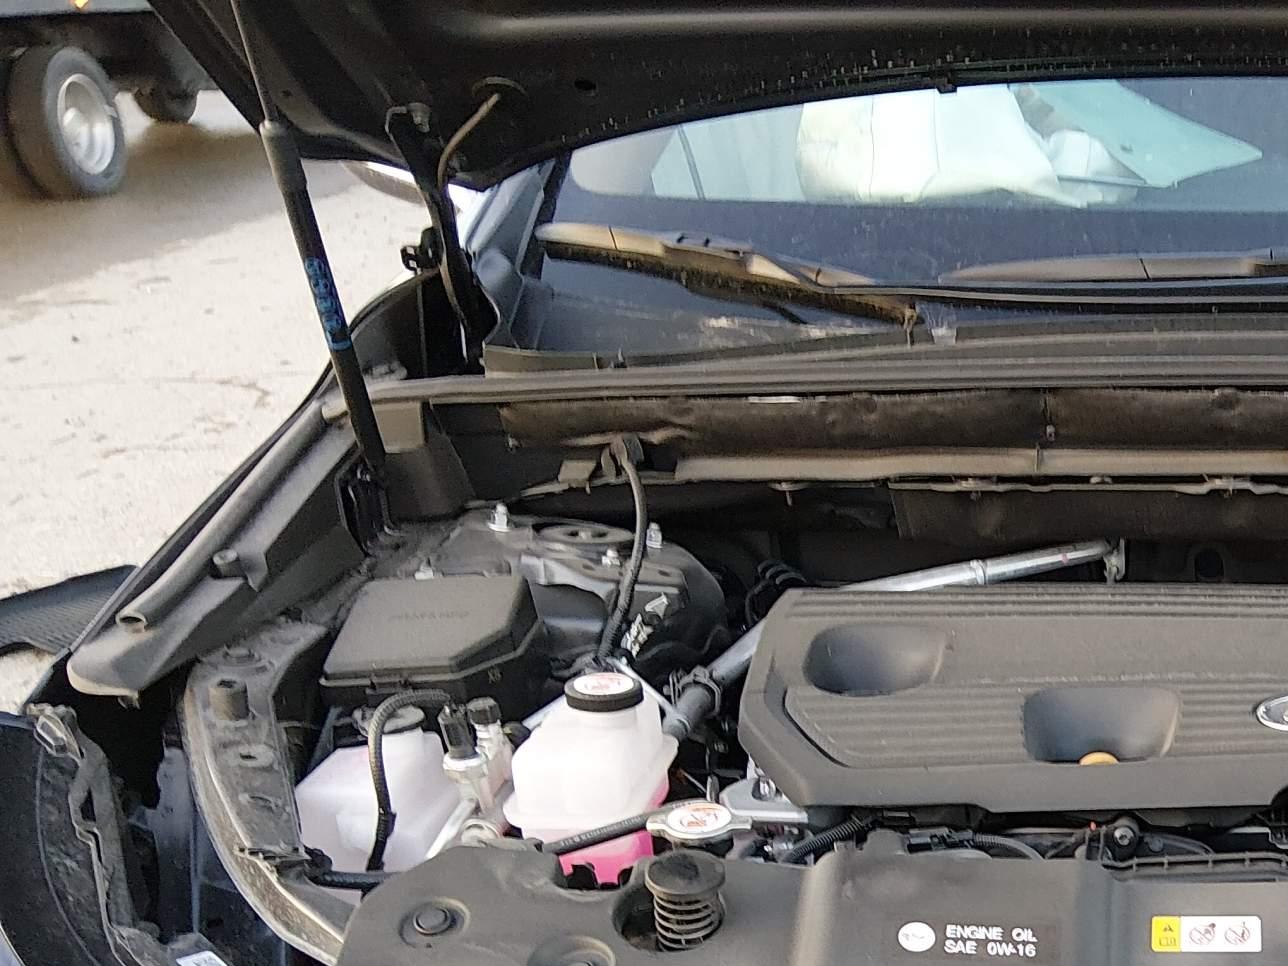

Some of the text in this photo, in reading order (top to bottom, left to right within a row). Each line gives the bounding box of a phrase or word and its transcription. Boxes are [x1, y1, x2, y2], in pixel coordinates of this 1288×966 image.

[946, 924, 1038, 942] ENGINE OIL
[944, 939, 1037, 957] SAE 0W-16
